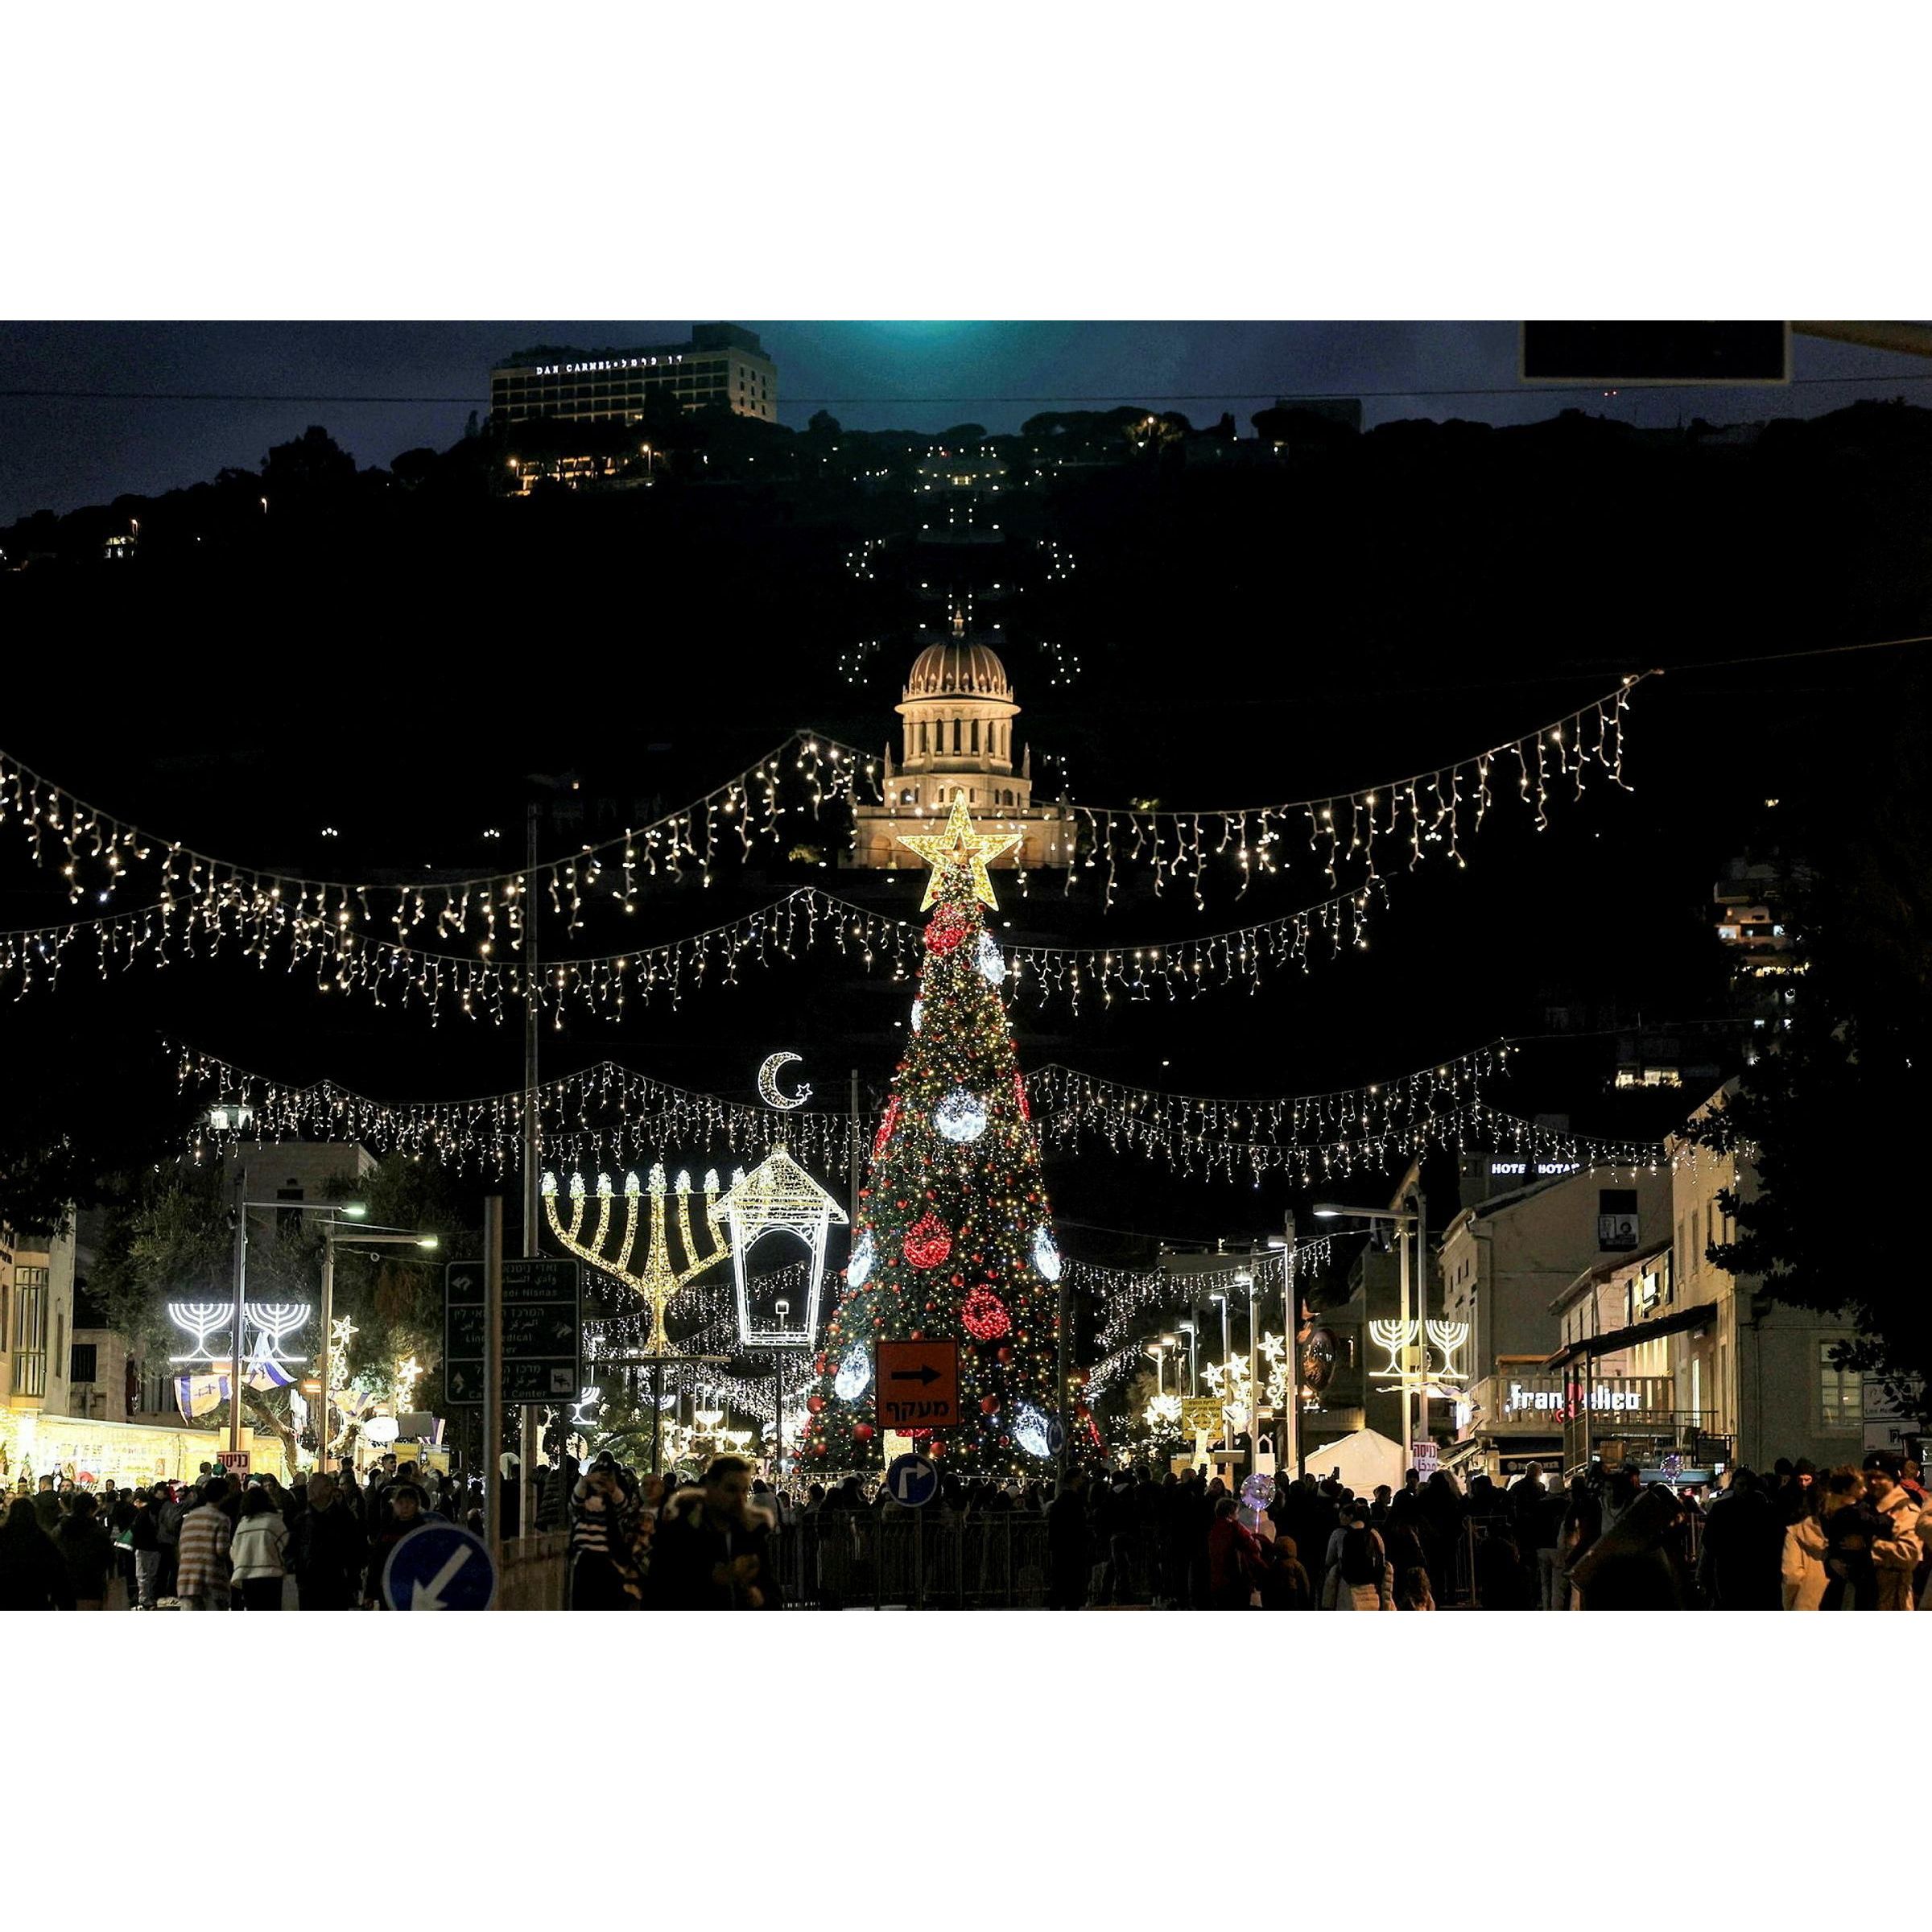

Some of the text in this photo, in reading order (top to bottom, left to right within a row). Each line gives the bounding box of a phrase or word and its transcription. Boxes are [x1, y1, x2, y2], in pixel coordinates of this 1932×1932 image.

[536, 360, 612, 375] DAN CARMEL
[1491, 1163, 1526, 1174] HOTE
[465, 1332, 533, 1344] Lin edical
[886, 1402, 949, 1422] מעקף
[1414, 1444, 1436, 1458] כניסה
